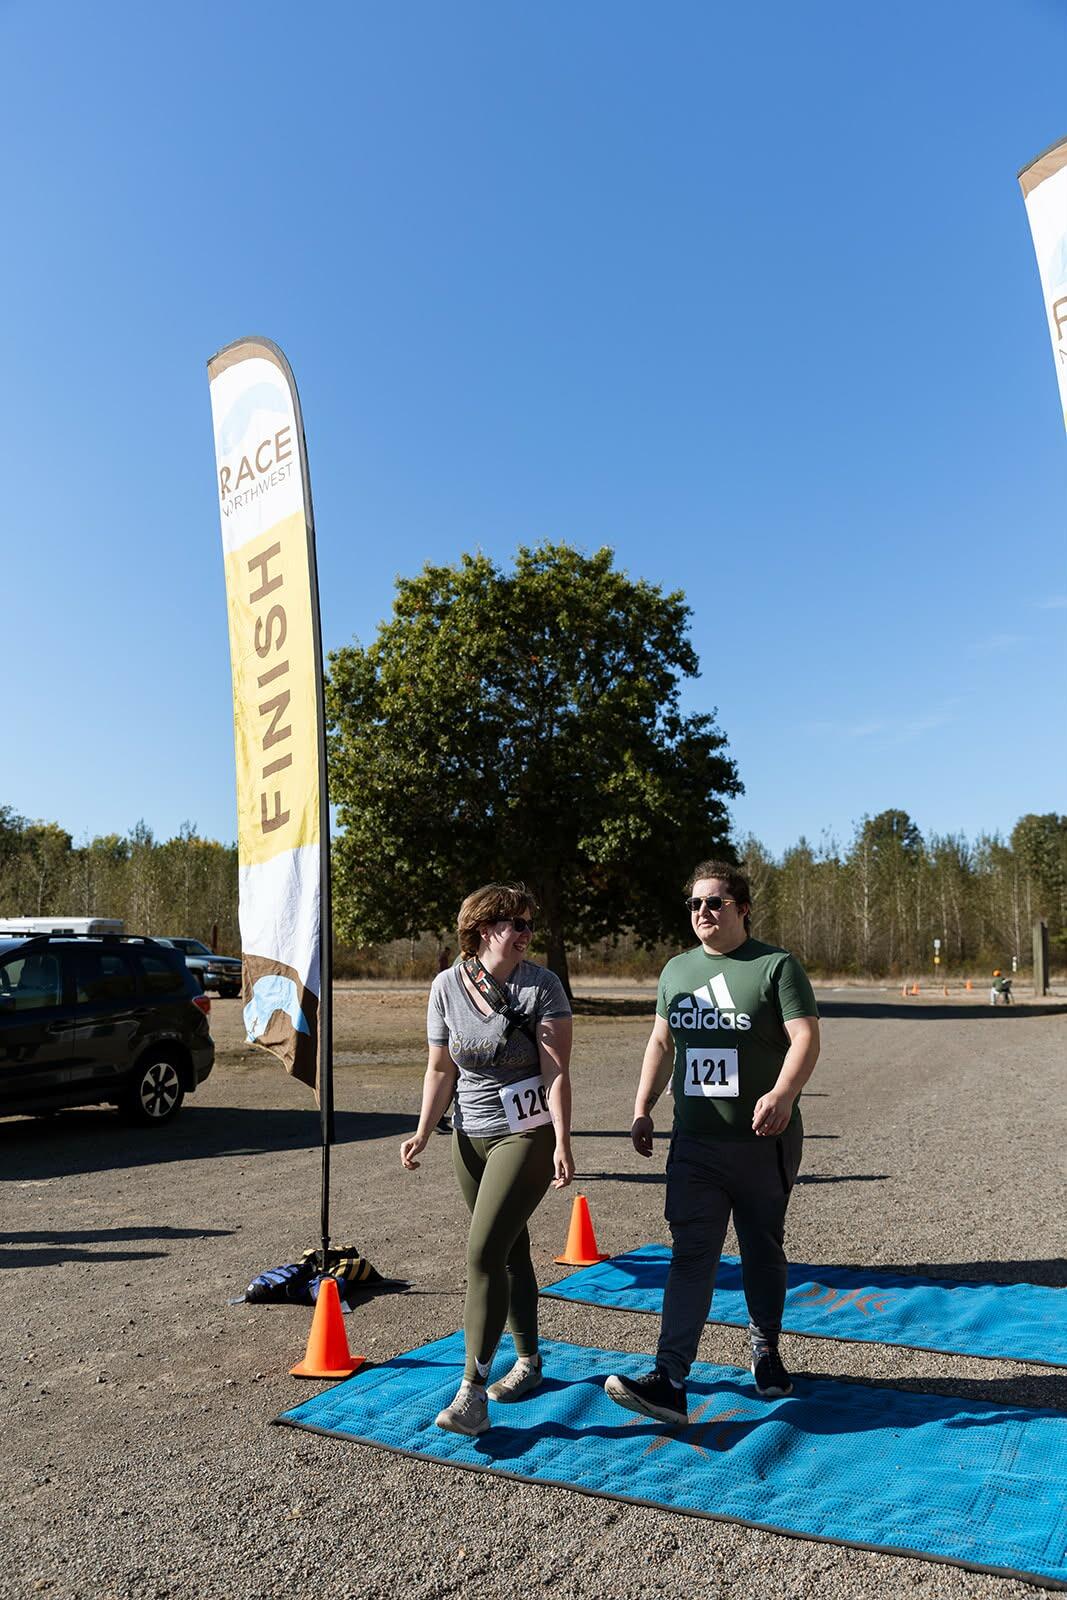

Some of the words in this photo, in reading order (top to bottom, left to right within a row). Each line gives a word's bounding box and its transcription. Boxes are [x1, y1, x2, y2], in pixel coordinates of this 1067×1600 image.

[219, 425, 292, 501] RACE
[247, 541, 293, 835] FINISH
[669, 1008, 752, 1031] adidas
[691, 1058, 729, 1086] 121
